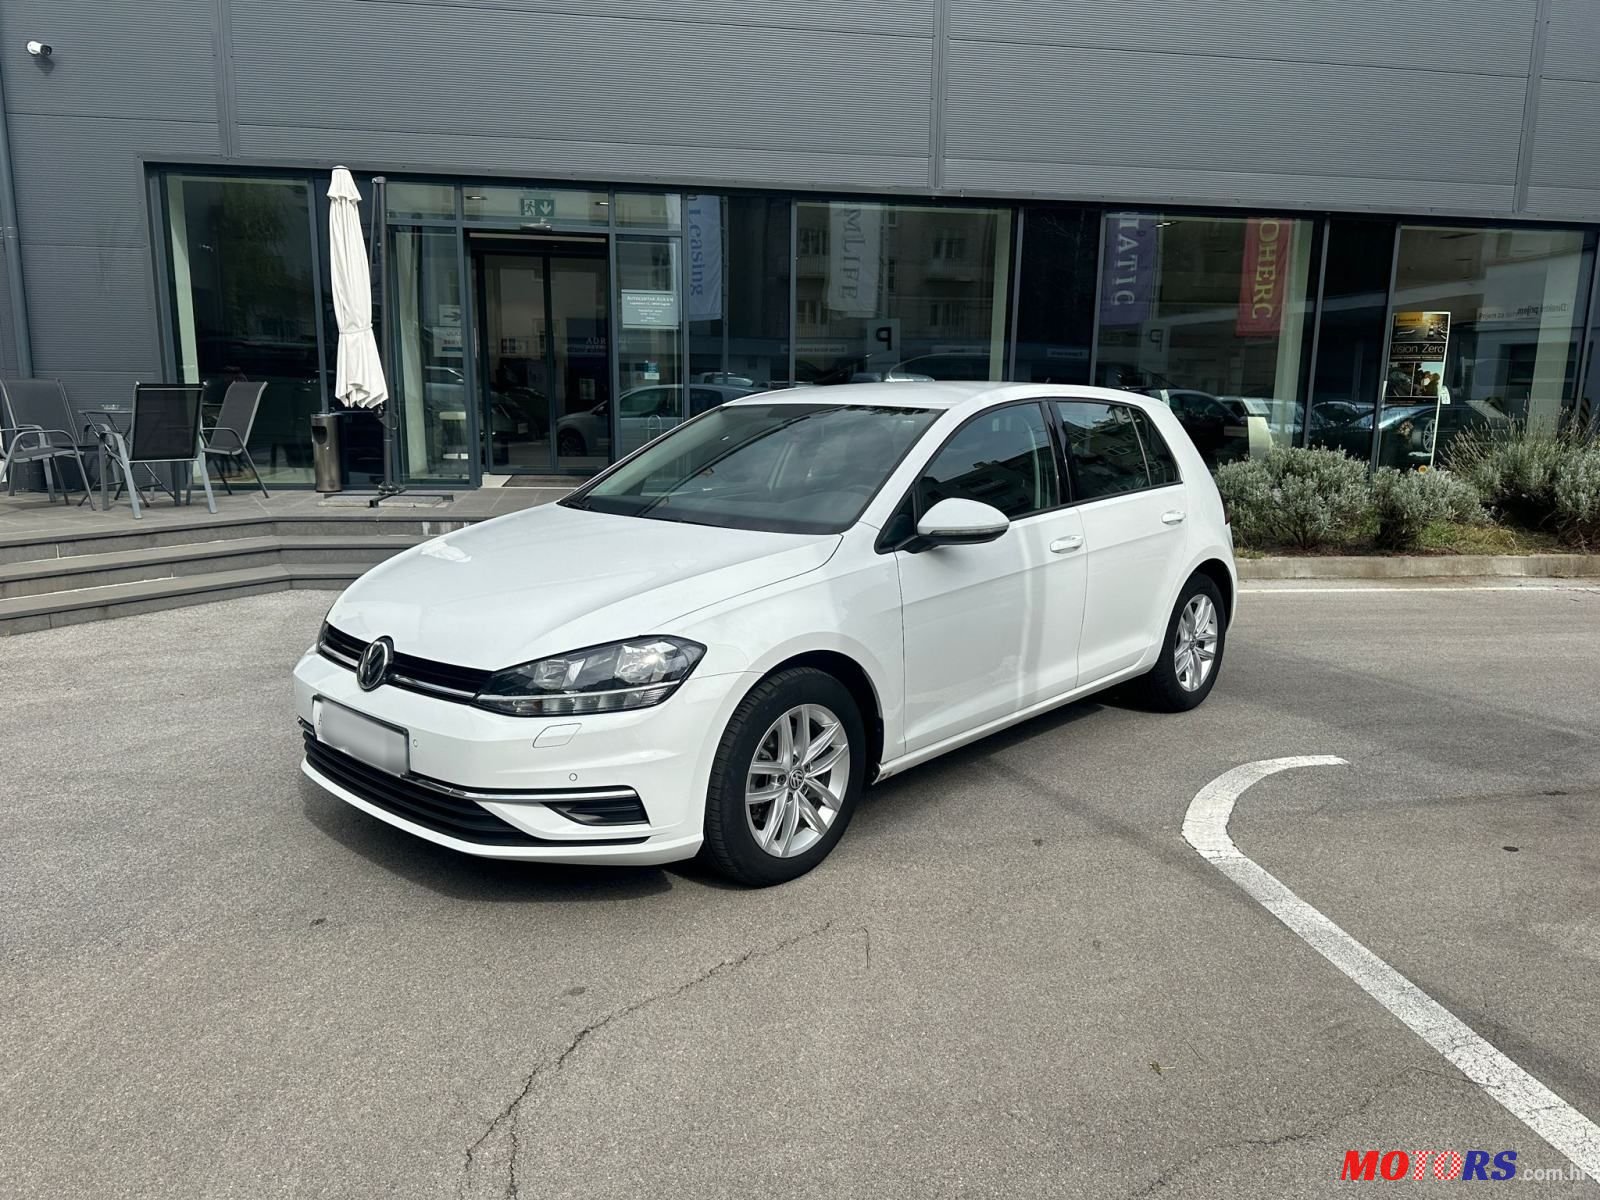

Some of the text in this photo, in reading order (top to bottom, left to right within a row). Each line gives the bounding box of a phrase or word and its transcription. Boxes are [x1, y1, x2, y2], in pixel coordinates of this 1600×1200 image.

[688, 207, 706, 297] Leasing
[1391, 343, 1445, 354] Vision Zero
